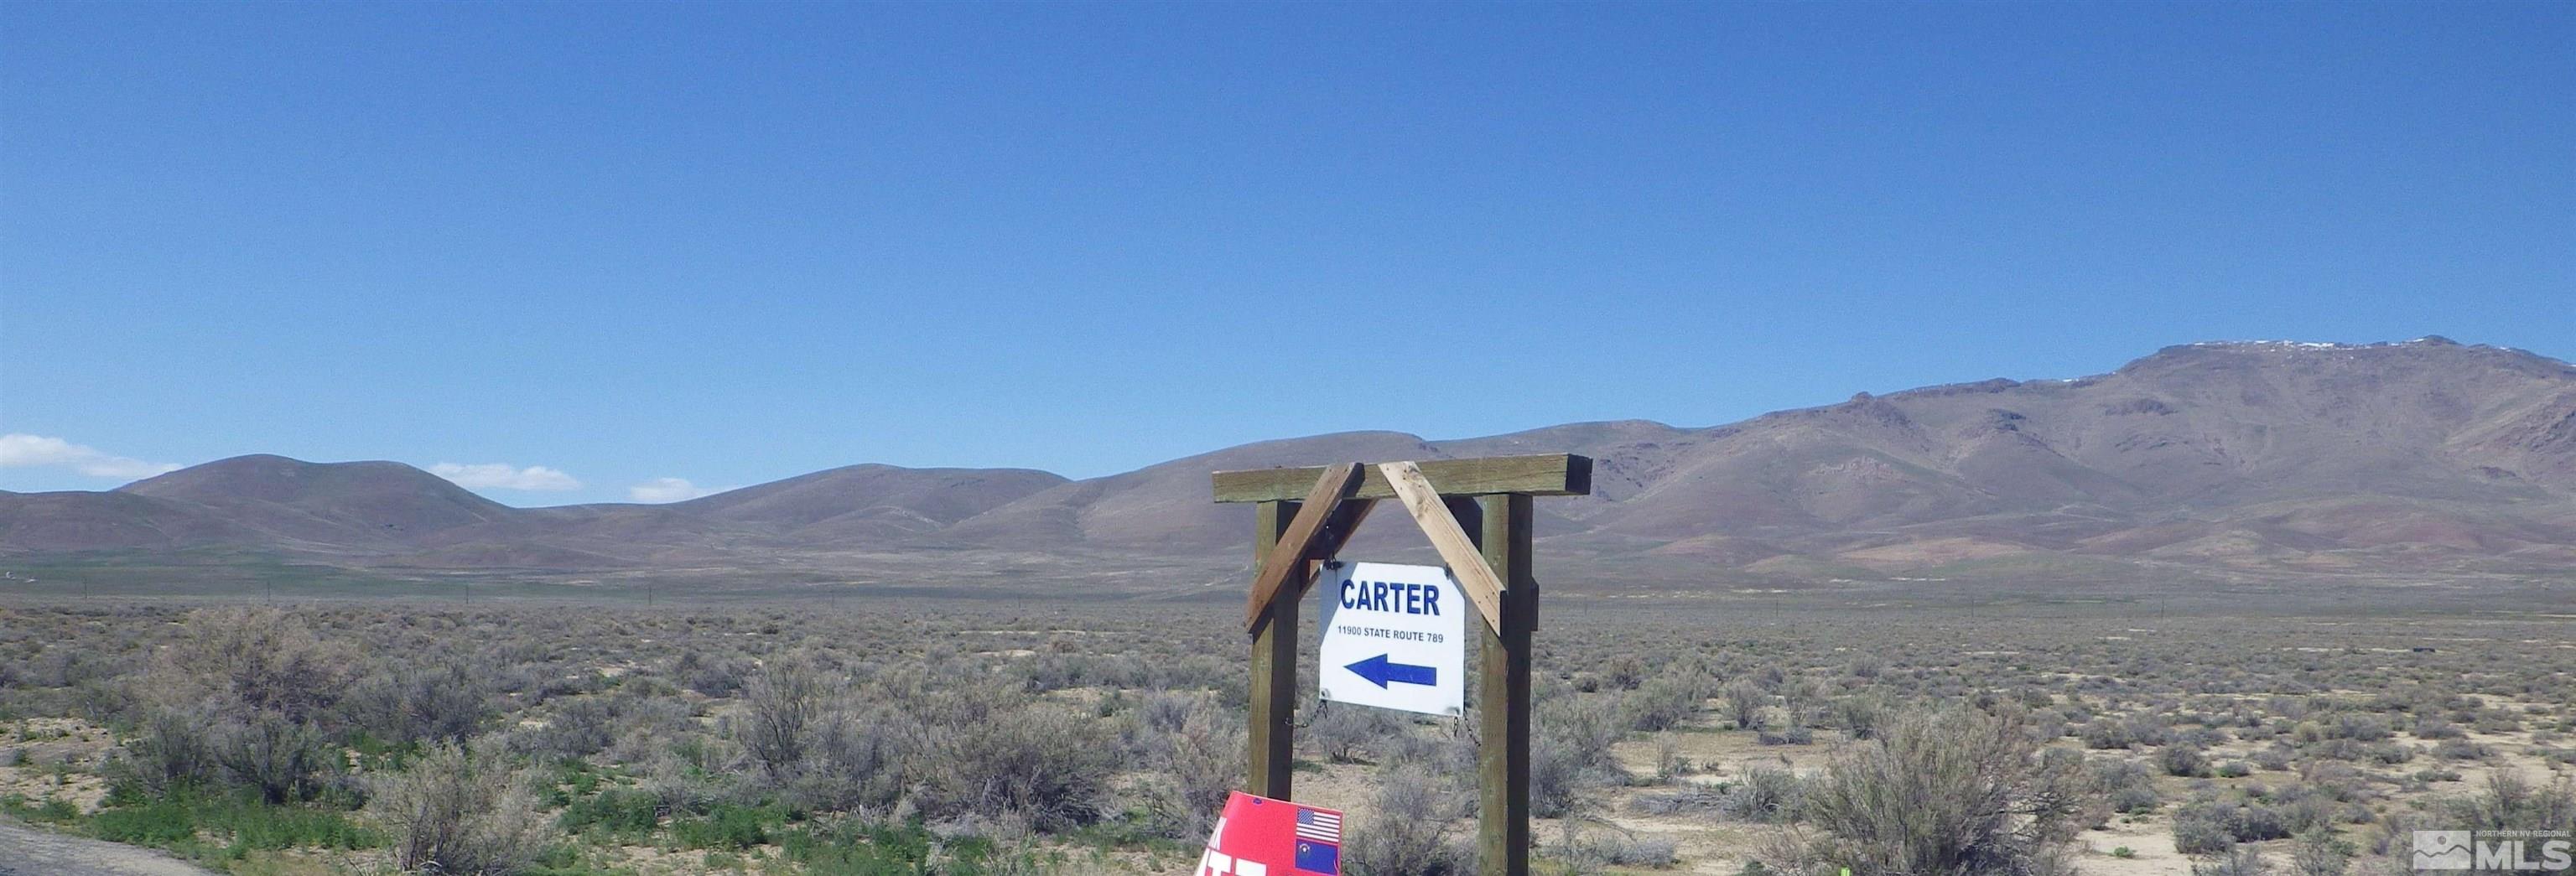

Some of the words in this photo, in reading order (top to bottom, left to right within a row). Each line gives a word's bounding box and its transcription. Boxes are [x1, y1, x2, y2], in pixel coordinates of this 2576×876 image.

[1341, 578, 1440, 615] CARTER
[1338, 625, 1362, 635] 11900
[1364, 628, 1390, 638] STATE
[1394, 630, 1424, 641] ROUTE
[1427, 633, 1443, 643] 789
